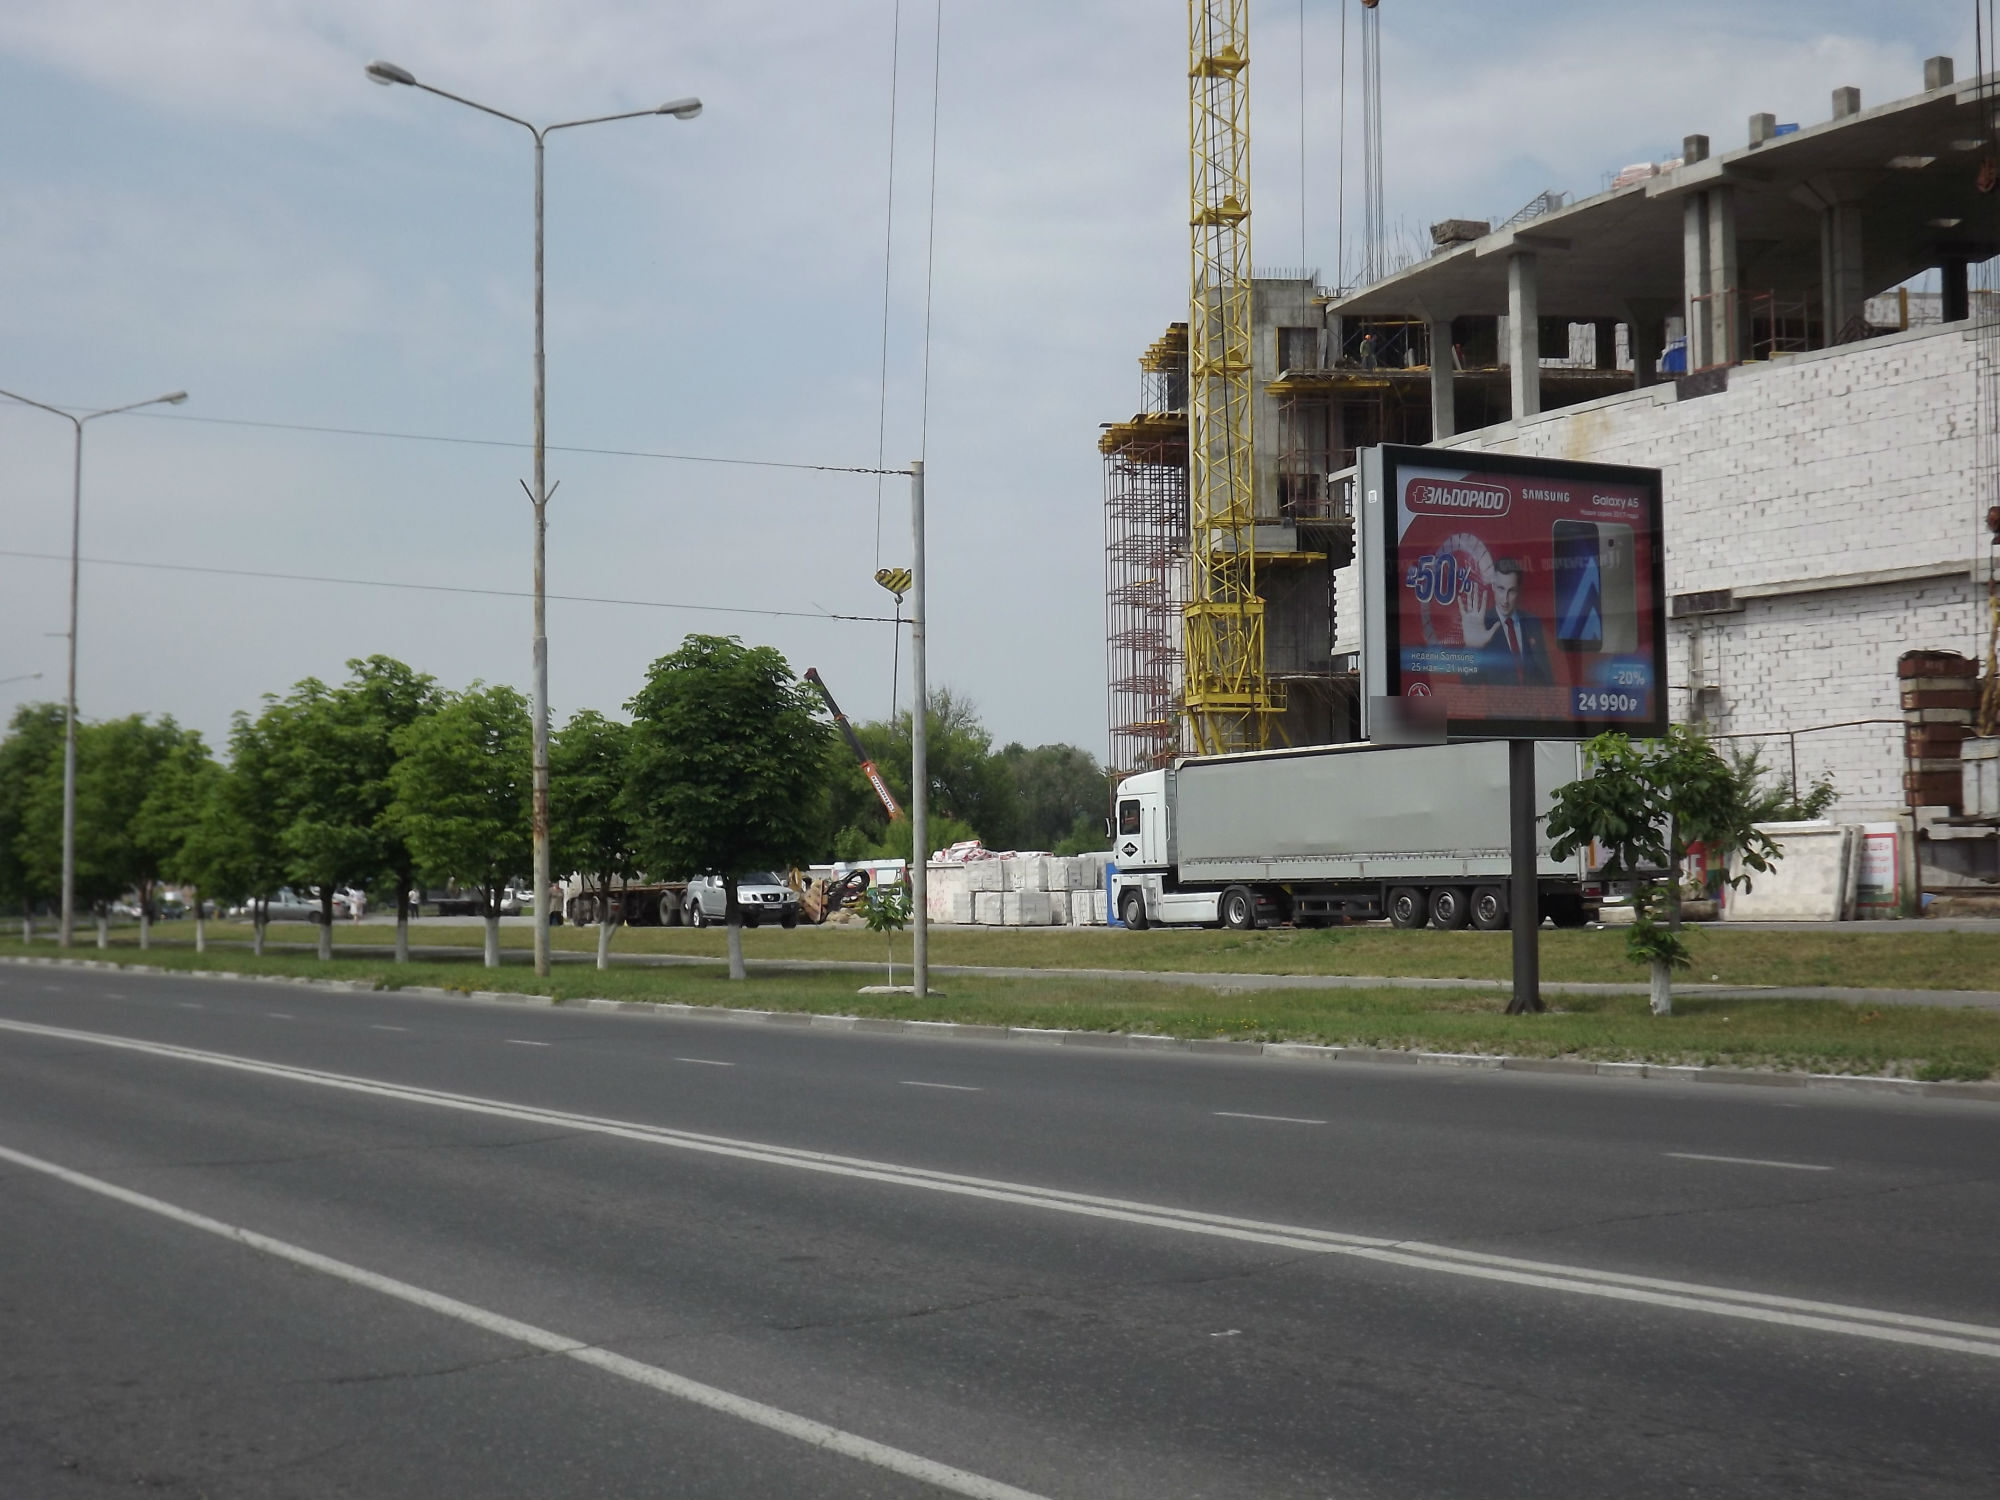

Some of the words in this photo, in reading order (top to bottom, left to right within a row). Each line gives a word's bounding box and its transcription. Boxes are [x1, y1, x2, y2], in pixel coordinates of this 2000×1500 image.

[1522, 488, 1570, 503] SAMSUNG
[1592, 495, 1626, 510] Galaxy
[1440, 651, 1475, 664] Samsung
[1411, 662, 1421, 672] 25
[1612, 670, 1646, 686] -20%
[1578, 692, 1598, 711] 24
